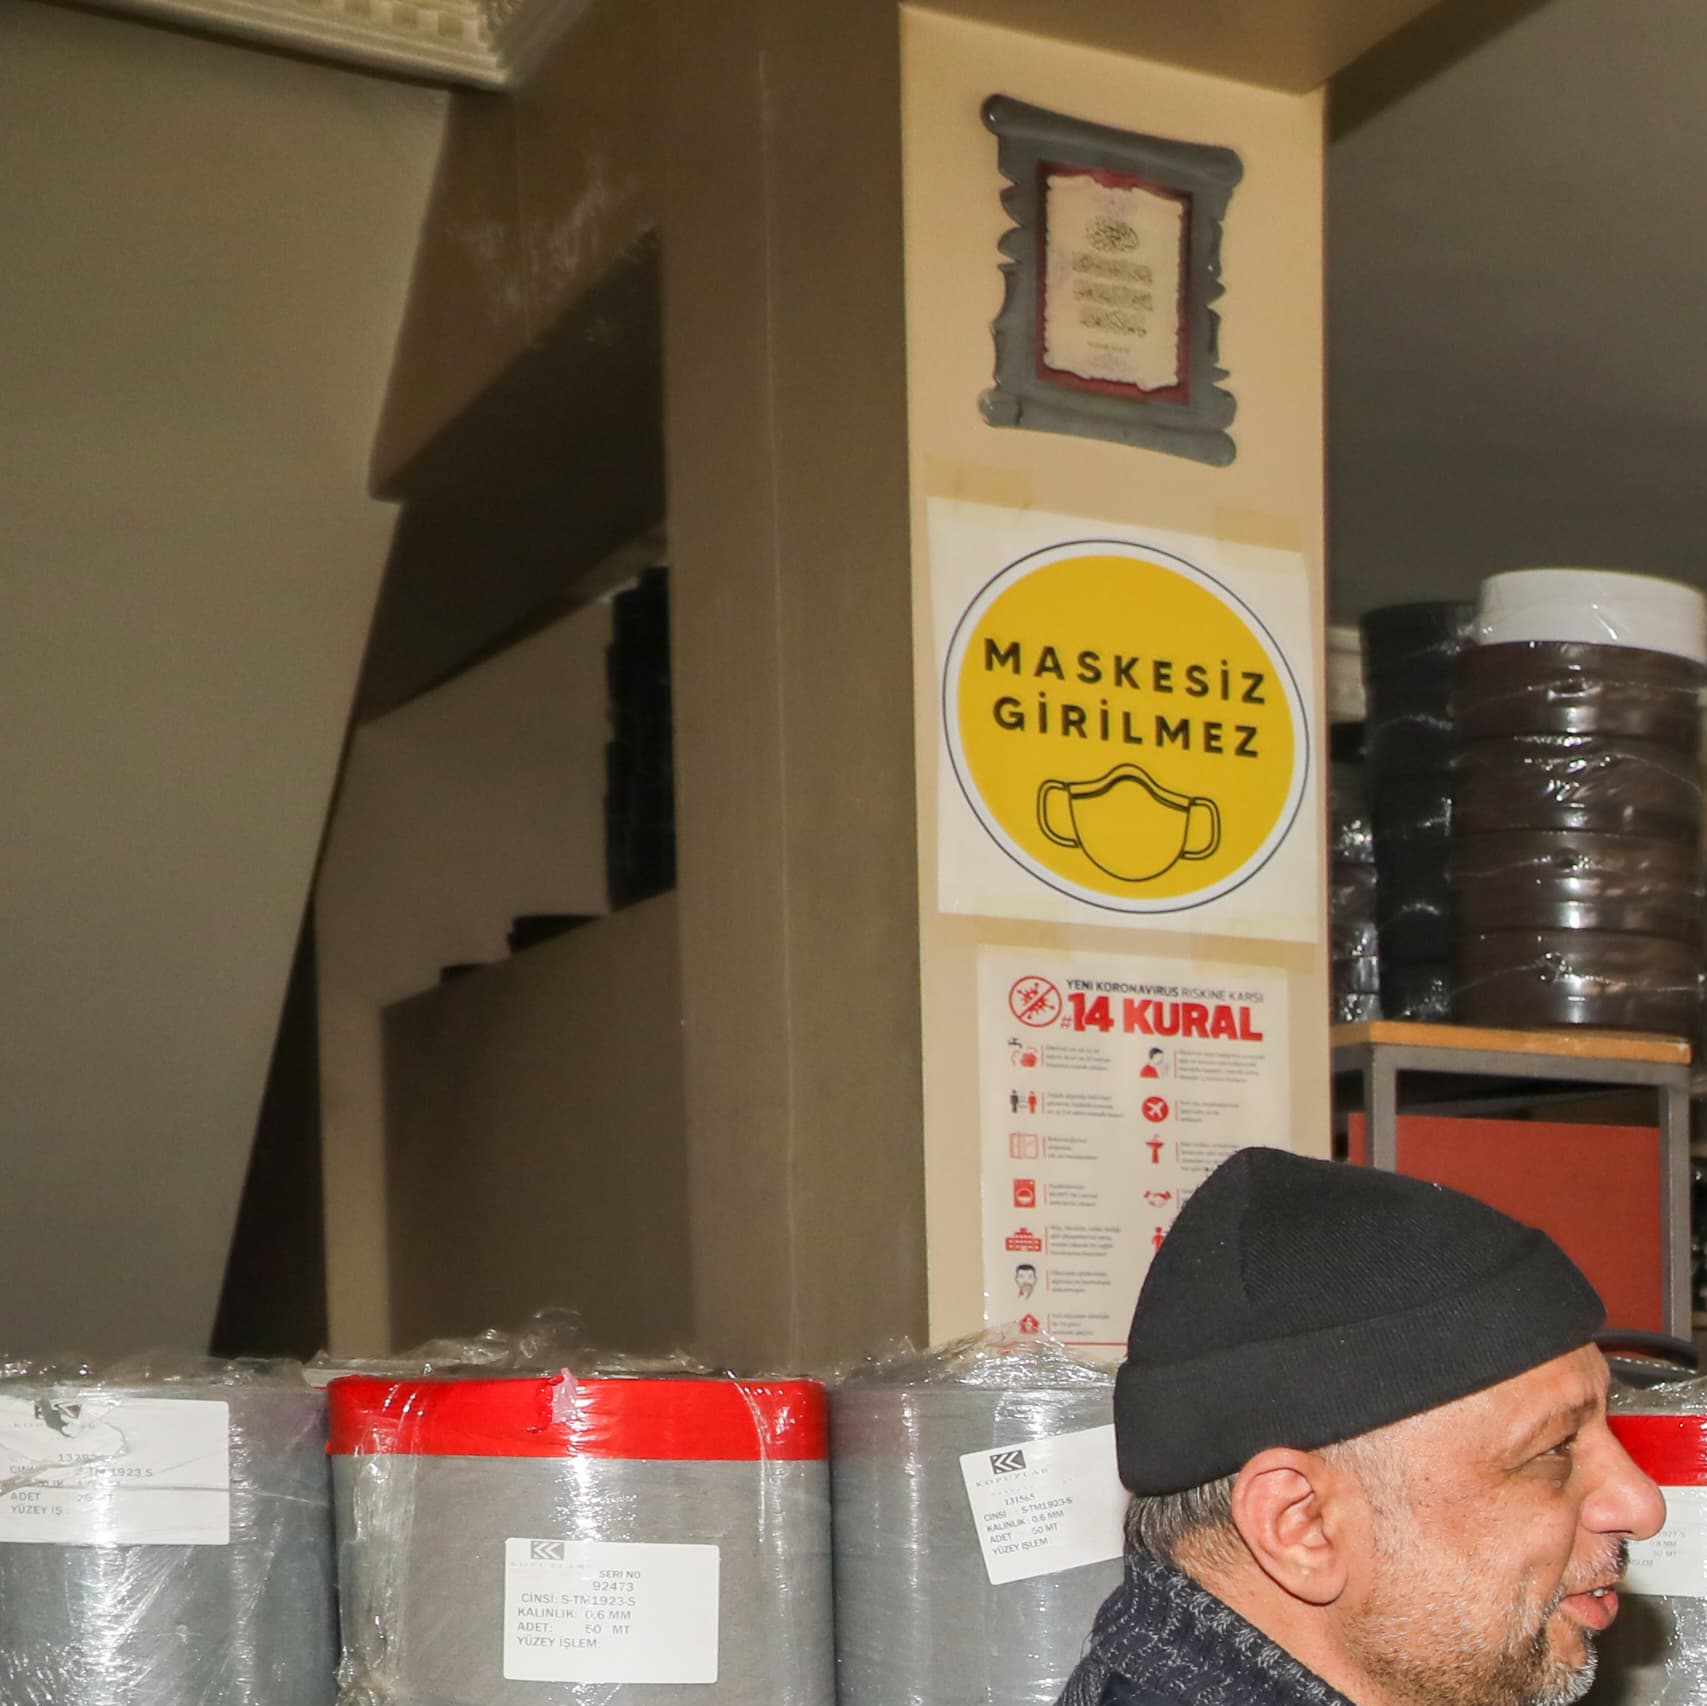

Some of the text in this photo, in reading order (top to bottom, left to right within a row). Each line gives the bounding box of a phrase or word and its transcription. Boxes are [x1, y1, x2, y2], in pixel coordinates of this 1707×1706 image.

[984, 637, 1266, 705] MASKESİZ
[993, 691, 1259, 758] GİRİLMEZ
[1123, 998, 1263, 1042] KURAL
[10, 1492, 40, 1501] ADET
[11, 1504, 47, 1515] YÜZEY
[990, 1532, 1012, 1544] ADET
[599, 1569, 641, 1580] SERİ NO
[592, 1581, 634, 1592] 92473
[608, 1611, 631, 1620] MM
[585, 1624, 602, 1634] 50
[612, 1625, 631, 1635] MT
[517, 1635, 556, 1648] YÜZEY
